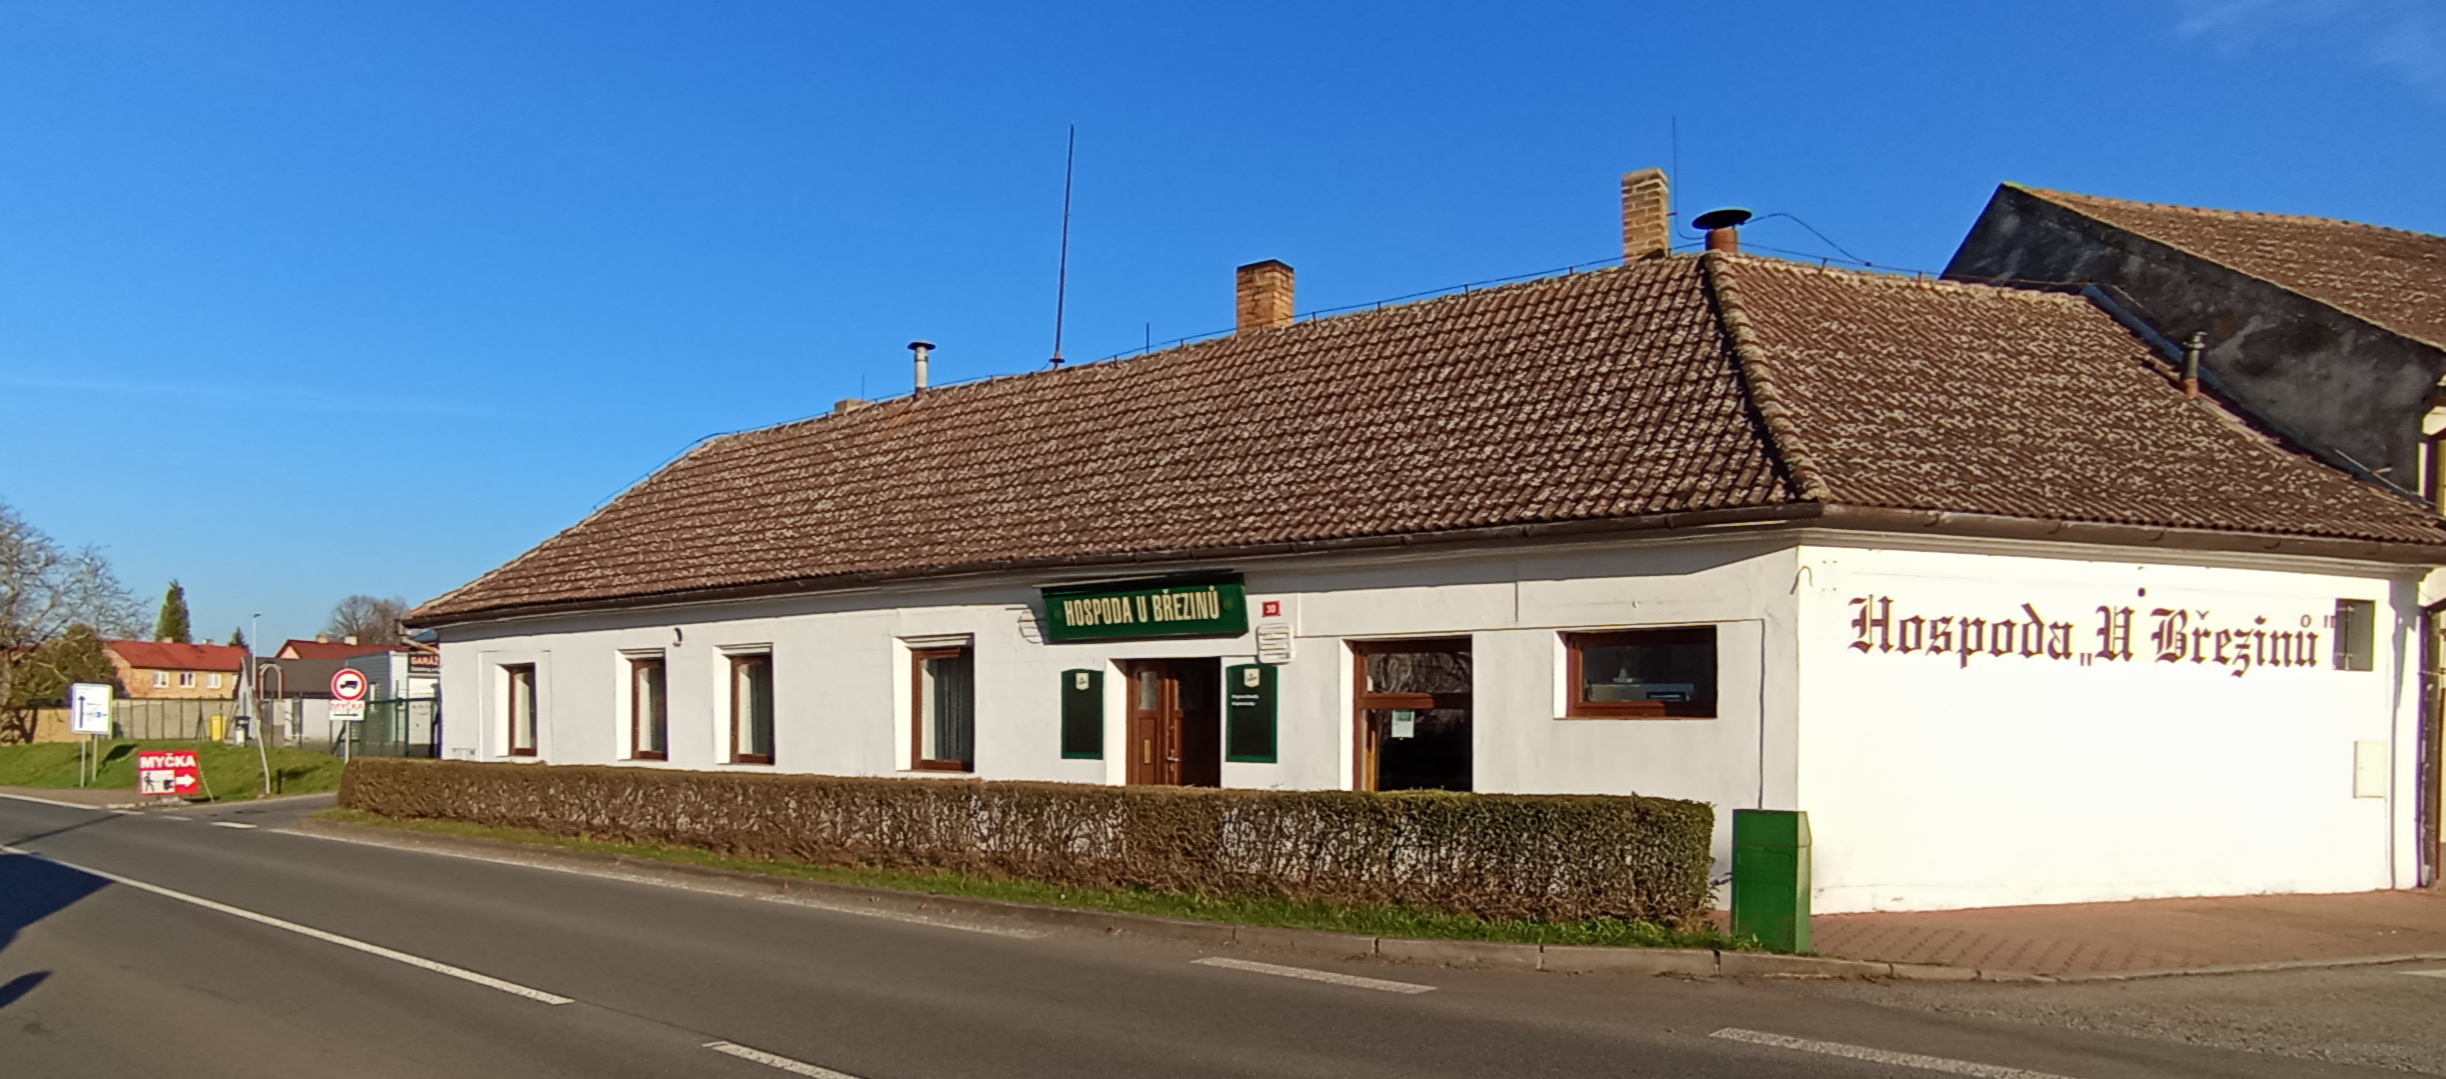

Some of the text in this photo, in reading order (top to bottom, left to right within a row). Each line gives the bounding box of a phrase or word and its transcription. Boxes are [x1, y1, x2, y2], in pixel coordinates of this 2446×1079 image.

[1064, 585, 1220, 627] HOSPODA U BŘEZINŮ
[1848, 594, 2076, 669] Hospoda
[330, 701, 364, 710] MYČKA
[140, 752, 196, 769] MYČKA
